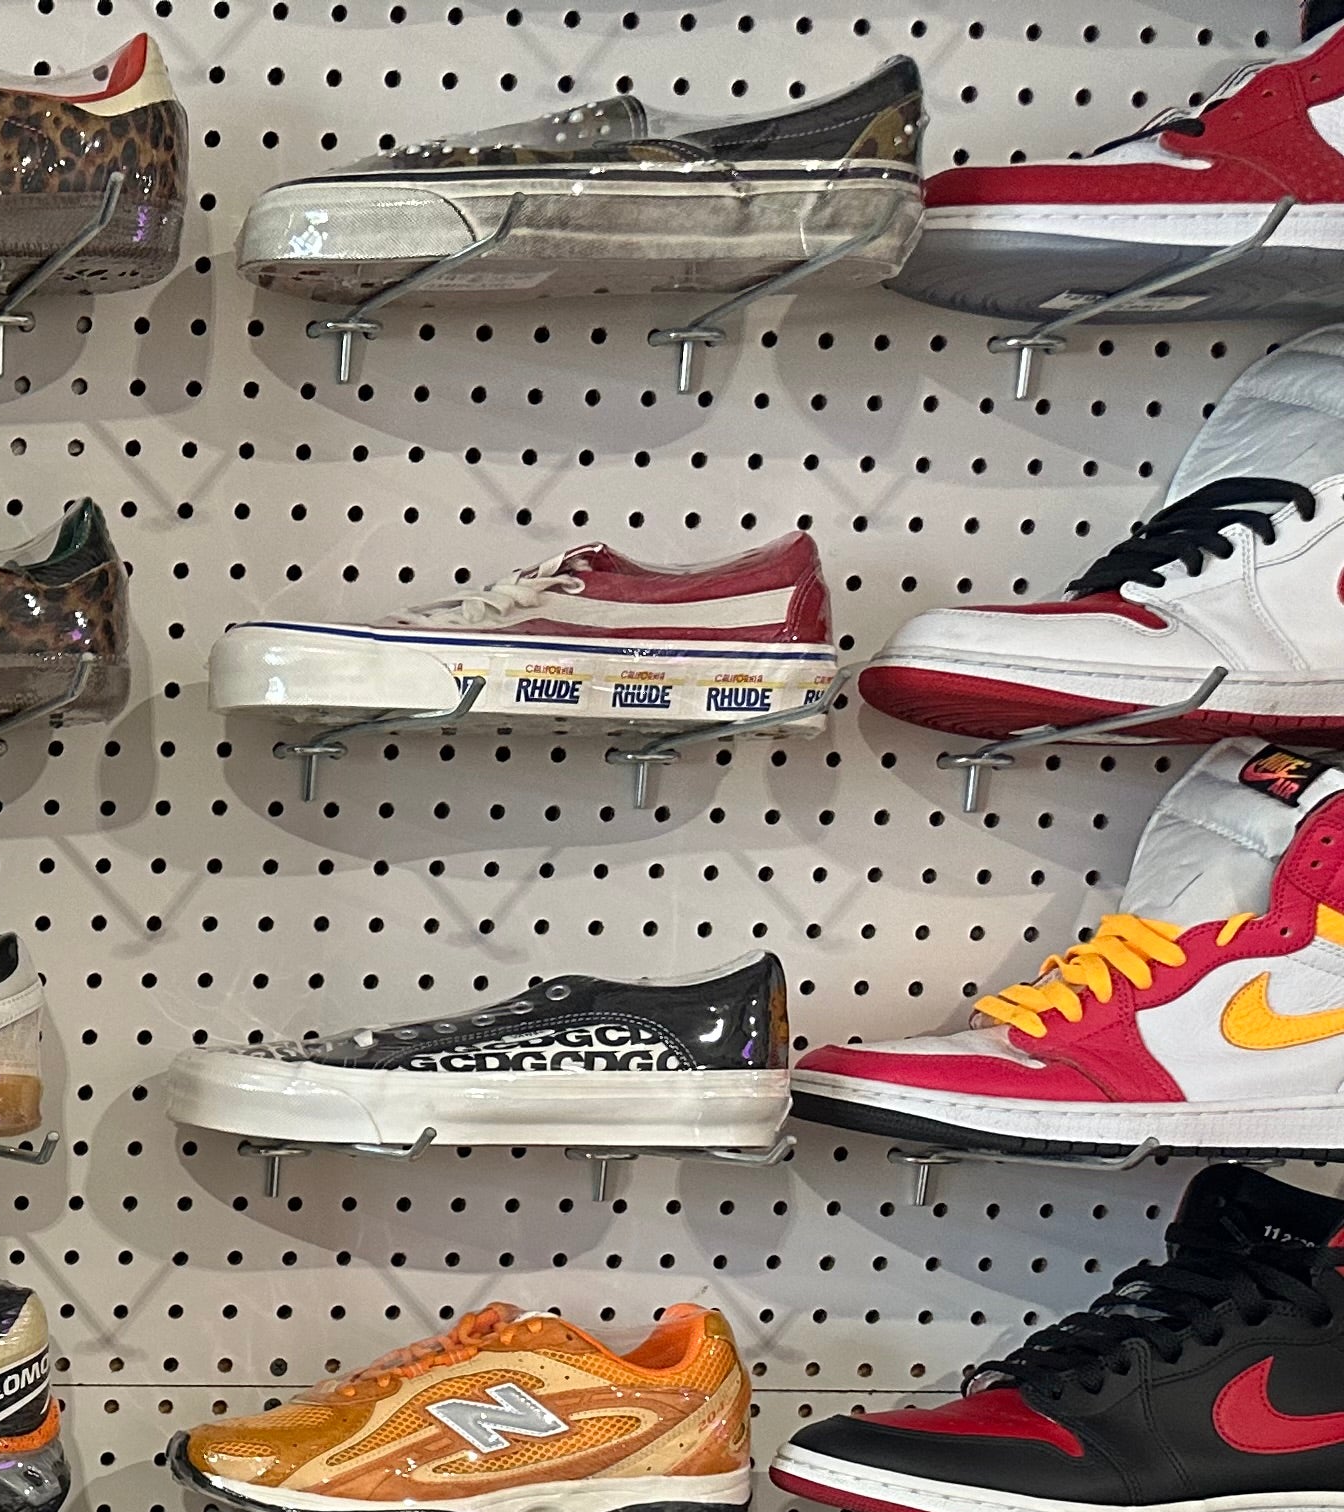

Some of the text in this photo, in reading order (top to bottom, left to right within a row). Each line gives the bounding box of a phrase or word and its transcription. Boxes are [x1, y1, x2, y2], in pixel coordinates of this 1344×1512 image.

[515, 677, 583, 705] RHUDE
[611, 683, 673, 709] RHUDE
[706, 686, 773, 712] RHUDE
[1267, 777, 1300, 800] AIR
